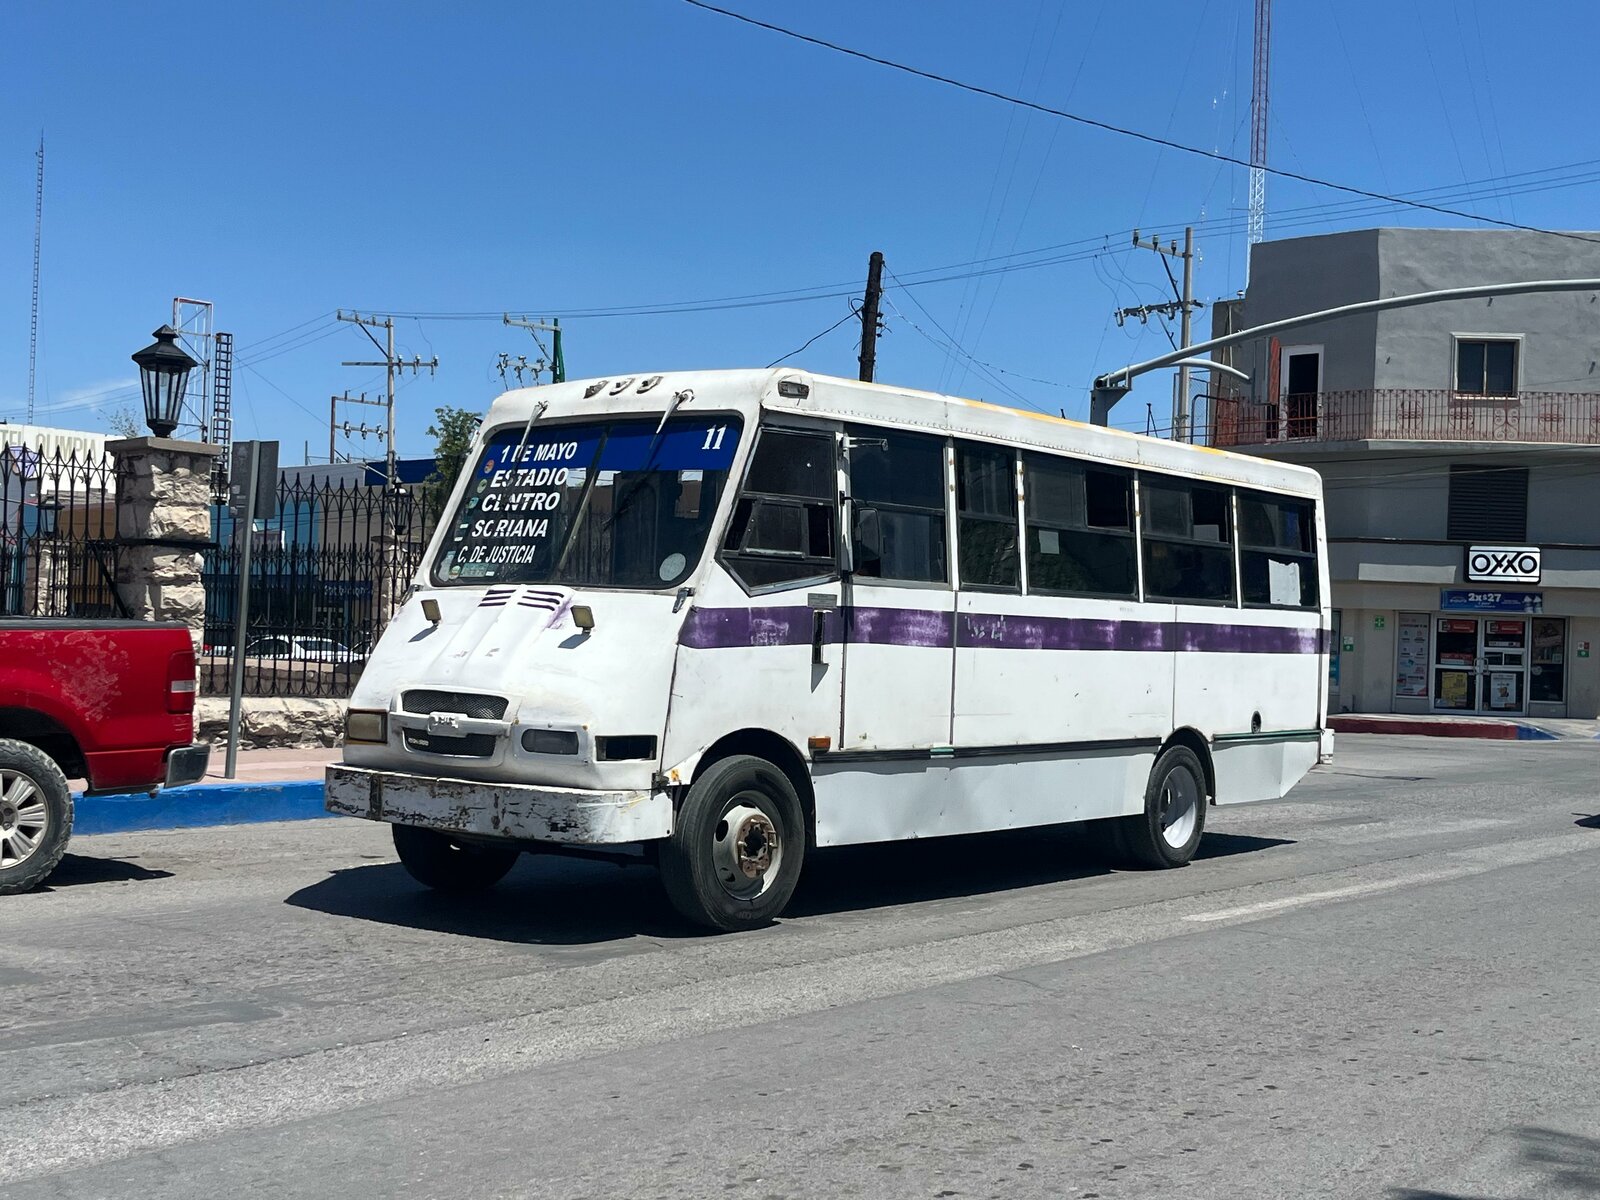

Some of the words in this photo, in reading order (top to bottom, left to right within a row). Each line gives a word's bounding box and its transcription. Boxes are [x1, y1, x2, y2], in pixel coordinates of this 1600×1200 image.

[701, 424, 727, 450] 11
[36, 433, 97, 463] OLIMPIA
[501, 445, 511, 463] 1
[534, 442, 578, 461] MAYO
[490, 467, 569, 488] ESTADIO
[481, 492, 561, 512] CENTRO
[457, 545, 469, 563] C.
[469, 545, 488, 563] DE
[485, 545, 536, 563] JUSTICIA
[1472, 553, 1538, 575] OXXO
